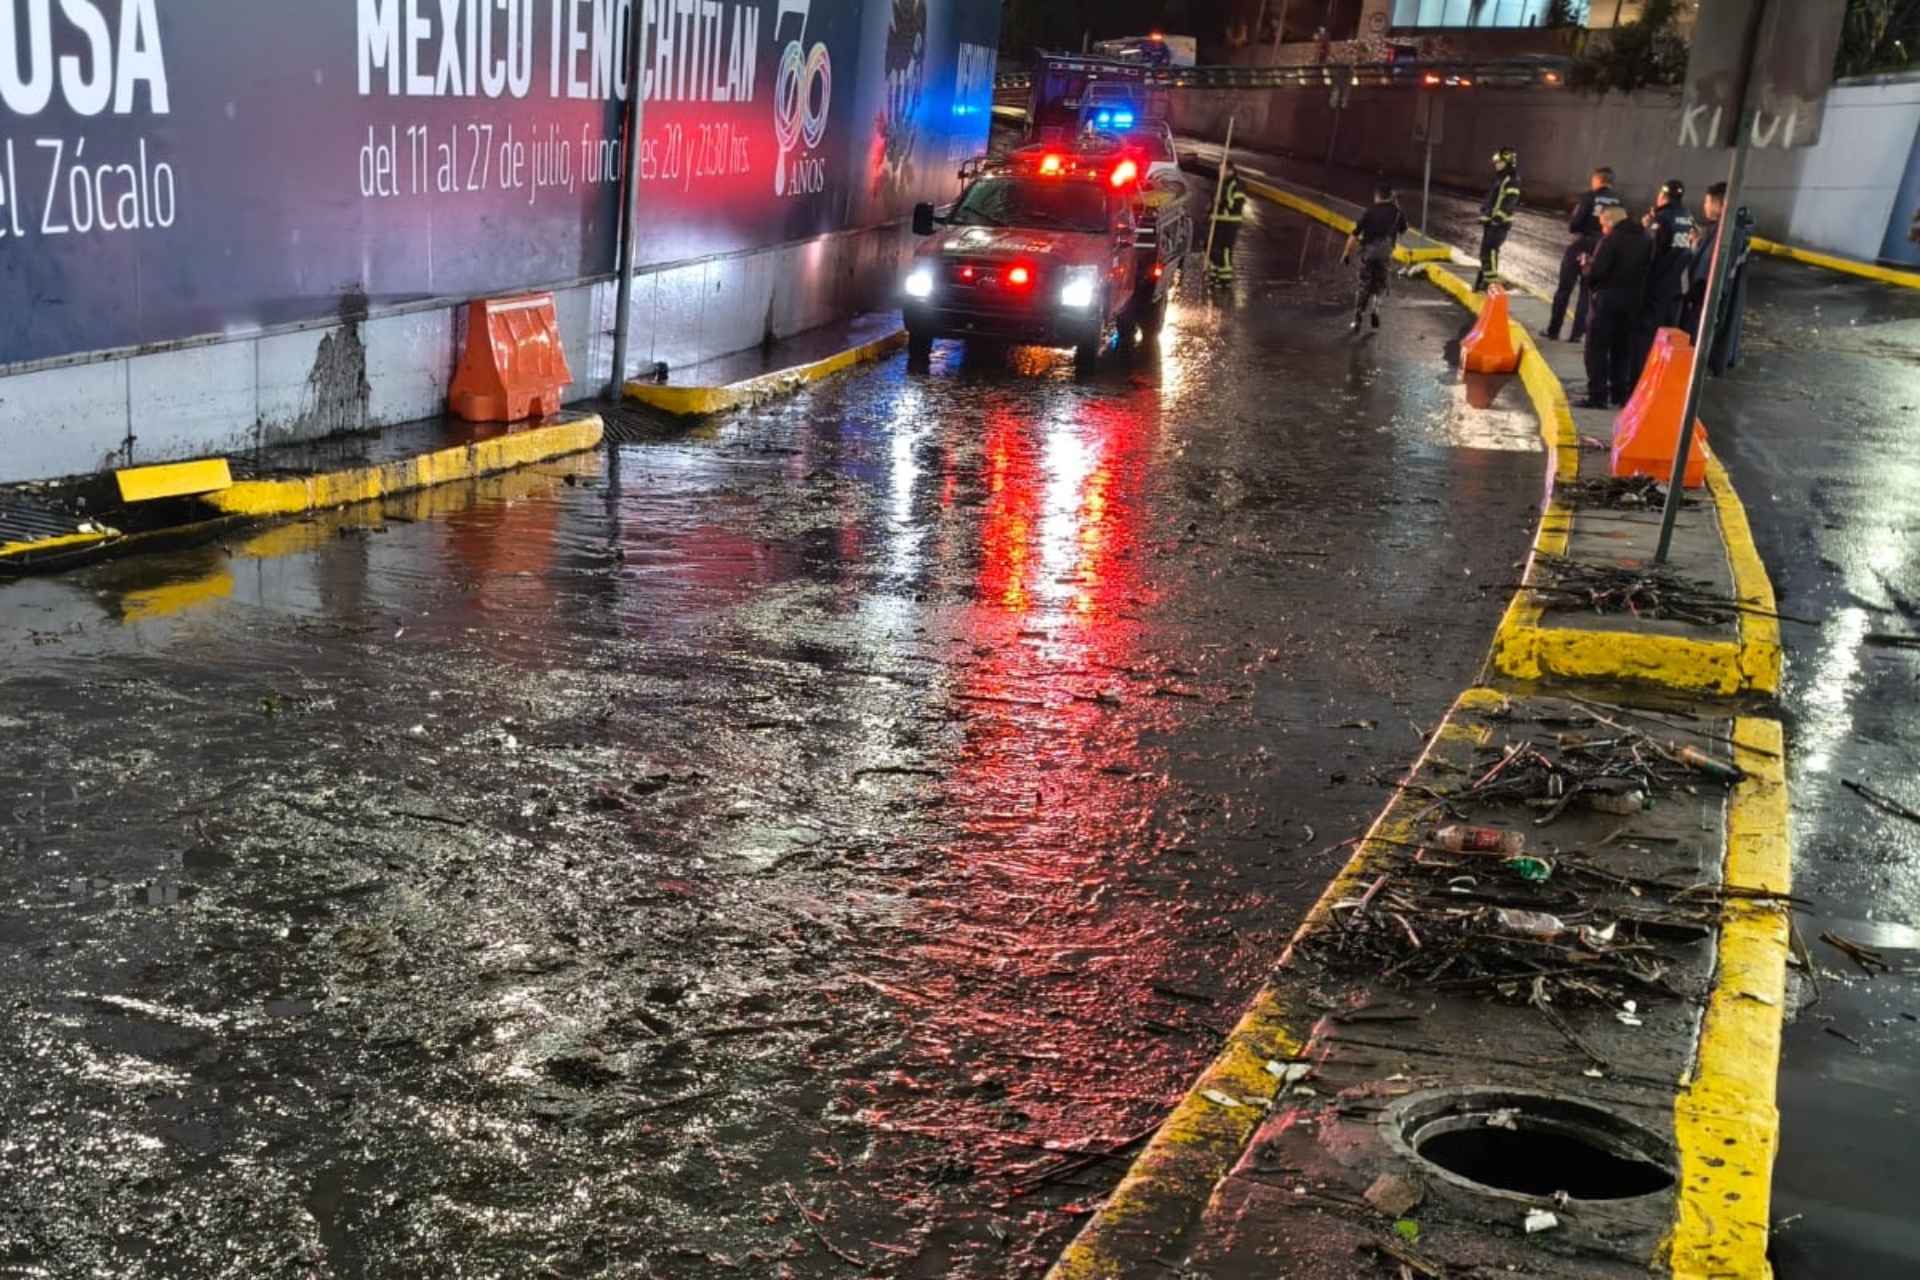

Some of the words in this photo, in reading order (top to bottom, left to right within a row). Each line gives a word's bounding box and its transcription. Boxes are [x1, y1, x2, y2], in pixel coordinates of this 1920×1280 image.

[549, 0, 760, 102] TENOCHTITLAN
[0, 138, 25, 237] l
[35, 136, 175, 233] Zócalo
[359, 124, 400, 197] del
[406, 125, 428, 194] 11
[437, 124, 460, 193] al
[466, 124, 493, 190] 27
[500, 123, 525, 189] de
[528, 120, 576, 205] julio,
[661, 122, 683, 179] 20
[682, 138, 695, 193] y
[787, 151, 825, 196] AÑOS
